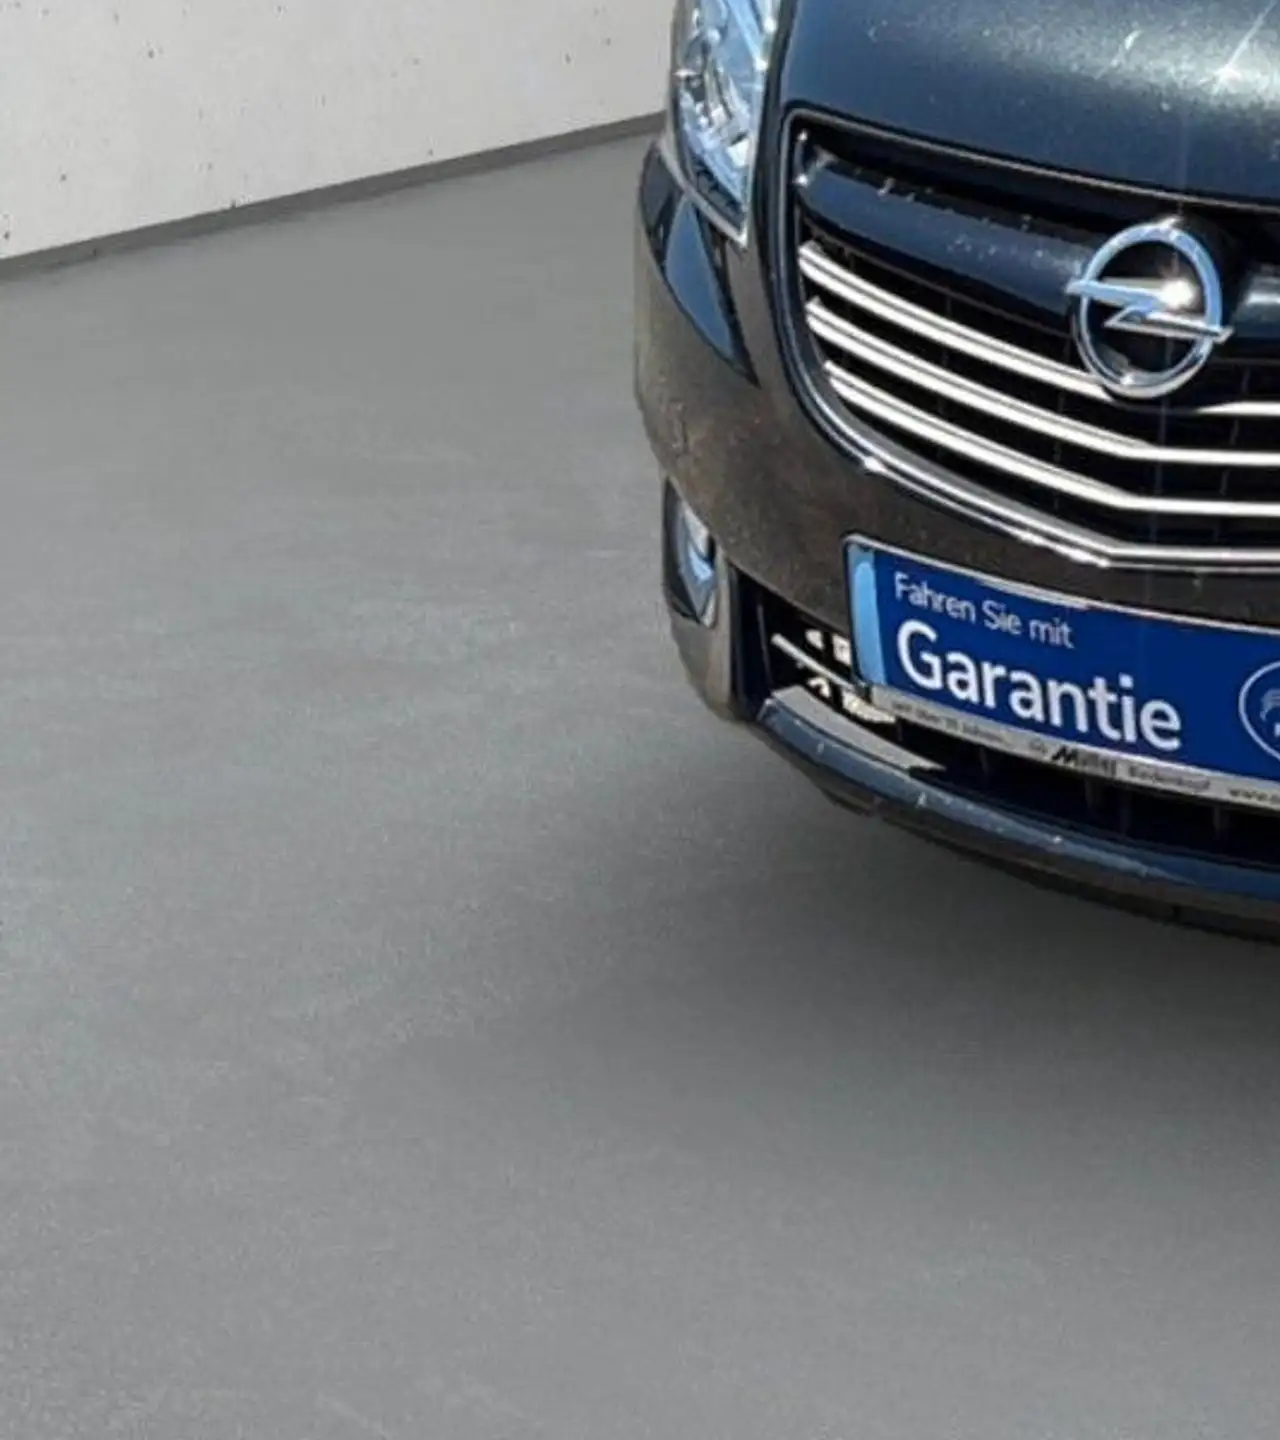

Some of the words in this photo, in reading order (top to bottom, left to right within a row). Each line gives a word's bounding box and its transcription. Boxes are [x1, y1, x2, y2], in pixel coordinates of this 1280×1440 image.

[894, 571, 976, 624] Fahren
[981, 599, 1023, 635] Sie
[1029, 618, 1075, 650] mit
[897, 619, 1182, 752] Garantie
